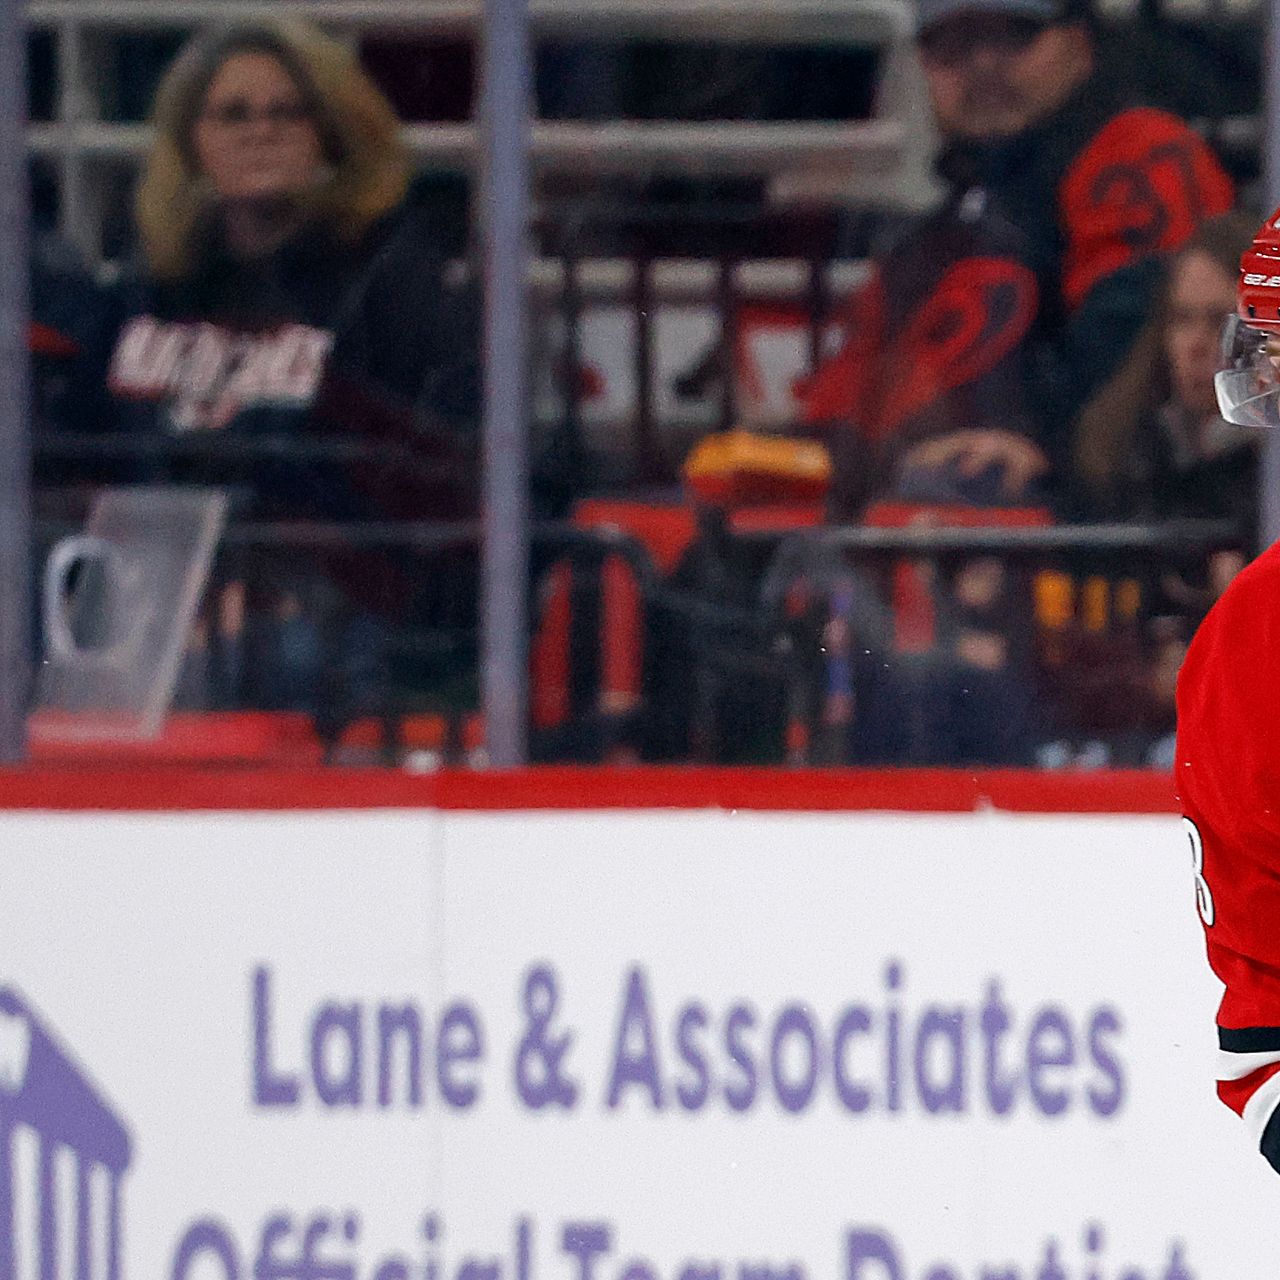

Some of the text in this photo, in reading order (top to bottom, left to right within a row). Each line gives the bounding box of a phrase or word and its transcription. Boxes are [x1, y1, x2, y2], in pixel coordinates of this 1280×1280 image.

[251, 959, 1125, 1117] Lane & Associates
